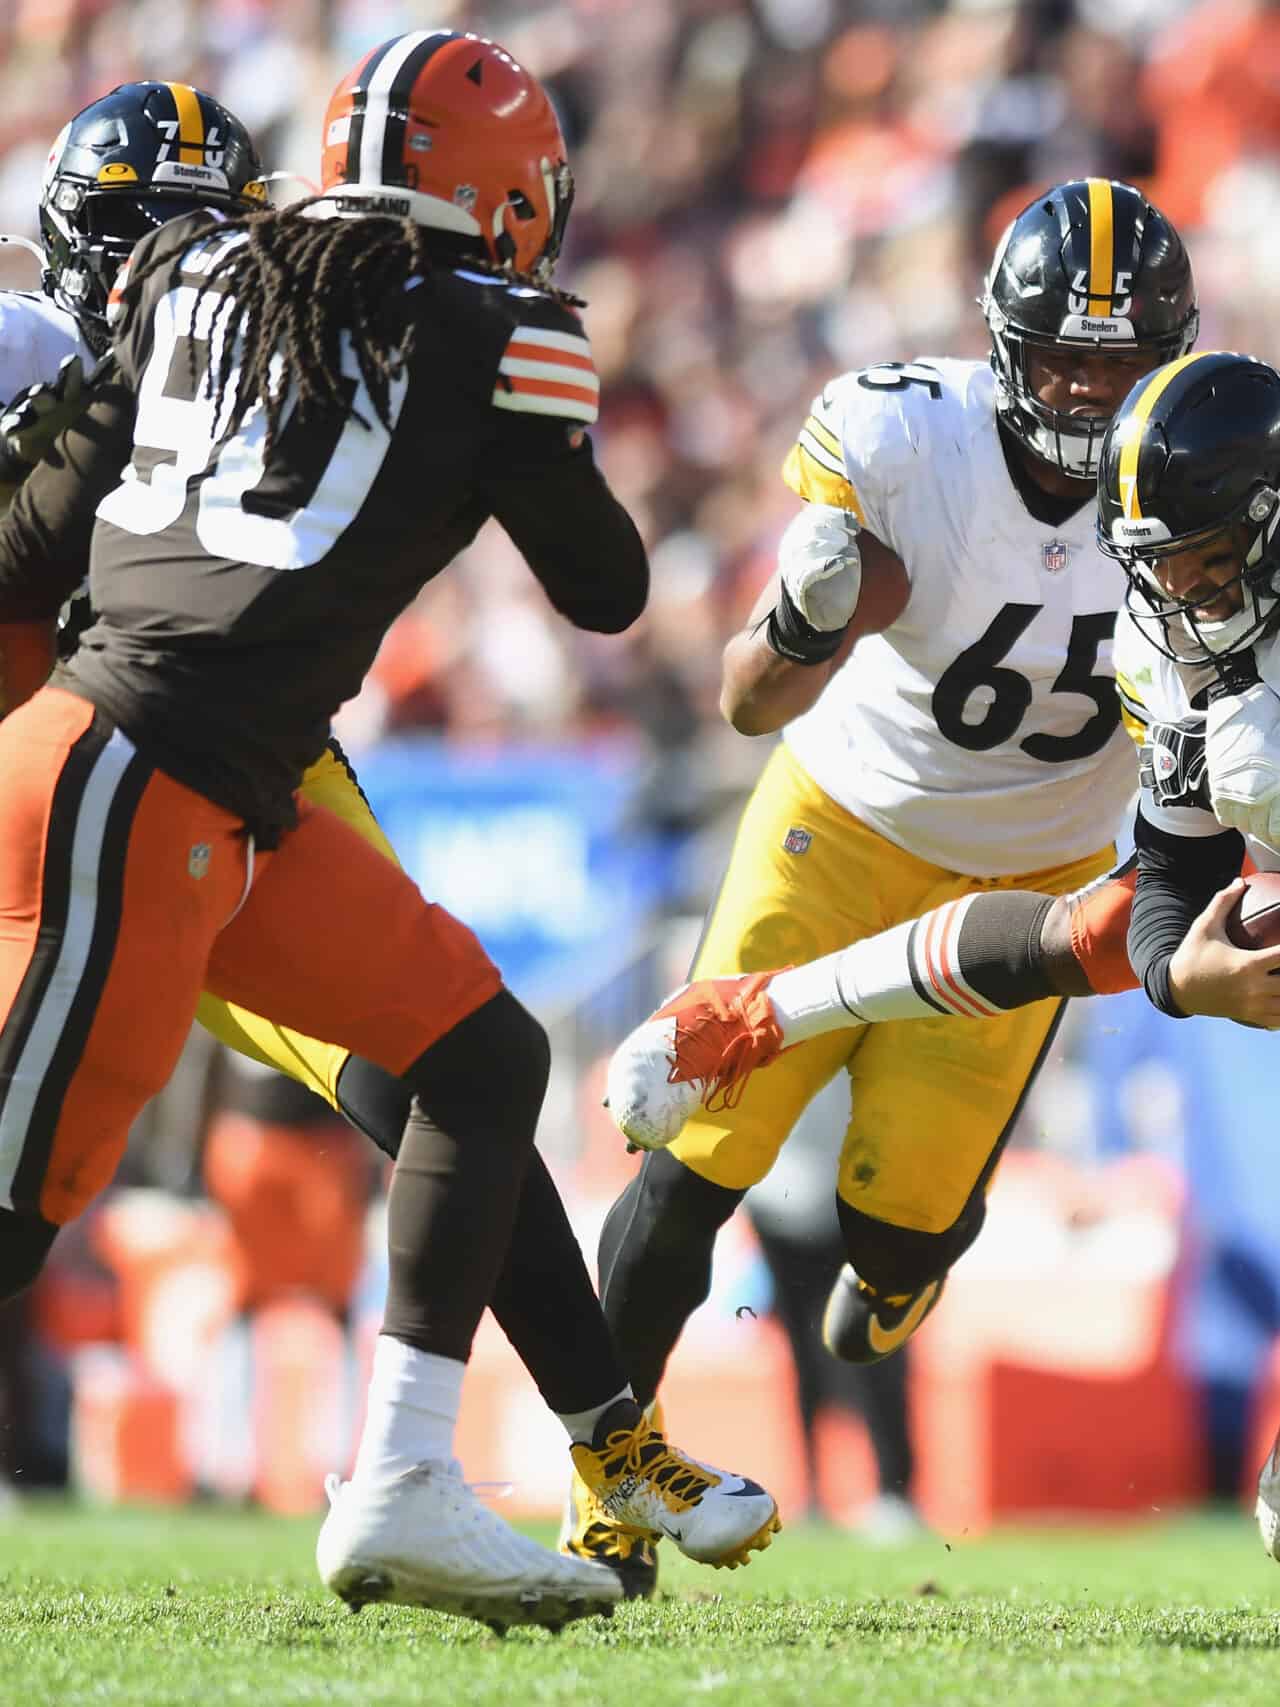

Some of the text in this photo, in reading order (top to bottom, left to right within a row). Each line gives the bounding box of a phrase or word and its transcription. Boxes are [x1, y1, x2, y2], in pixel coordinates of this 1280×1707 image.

[1068, 270, 1132, 316] 65
[1081, 319, 1119, 333] Steelers
[1121, 524, 1153, 537] Steelers
[932, 602, 1123, 764] 65
